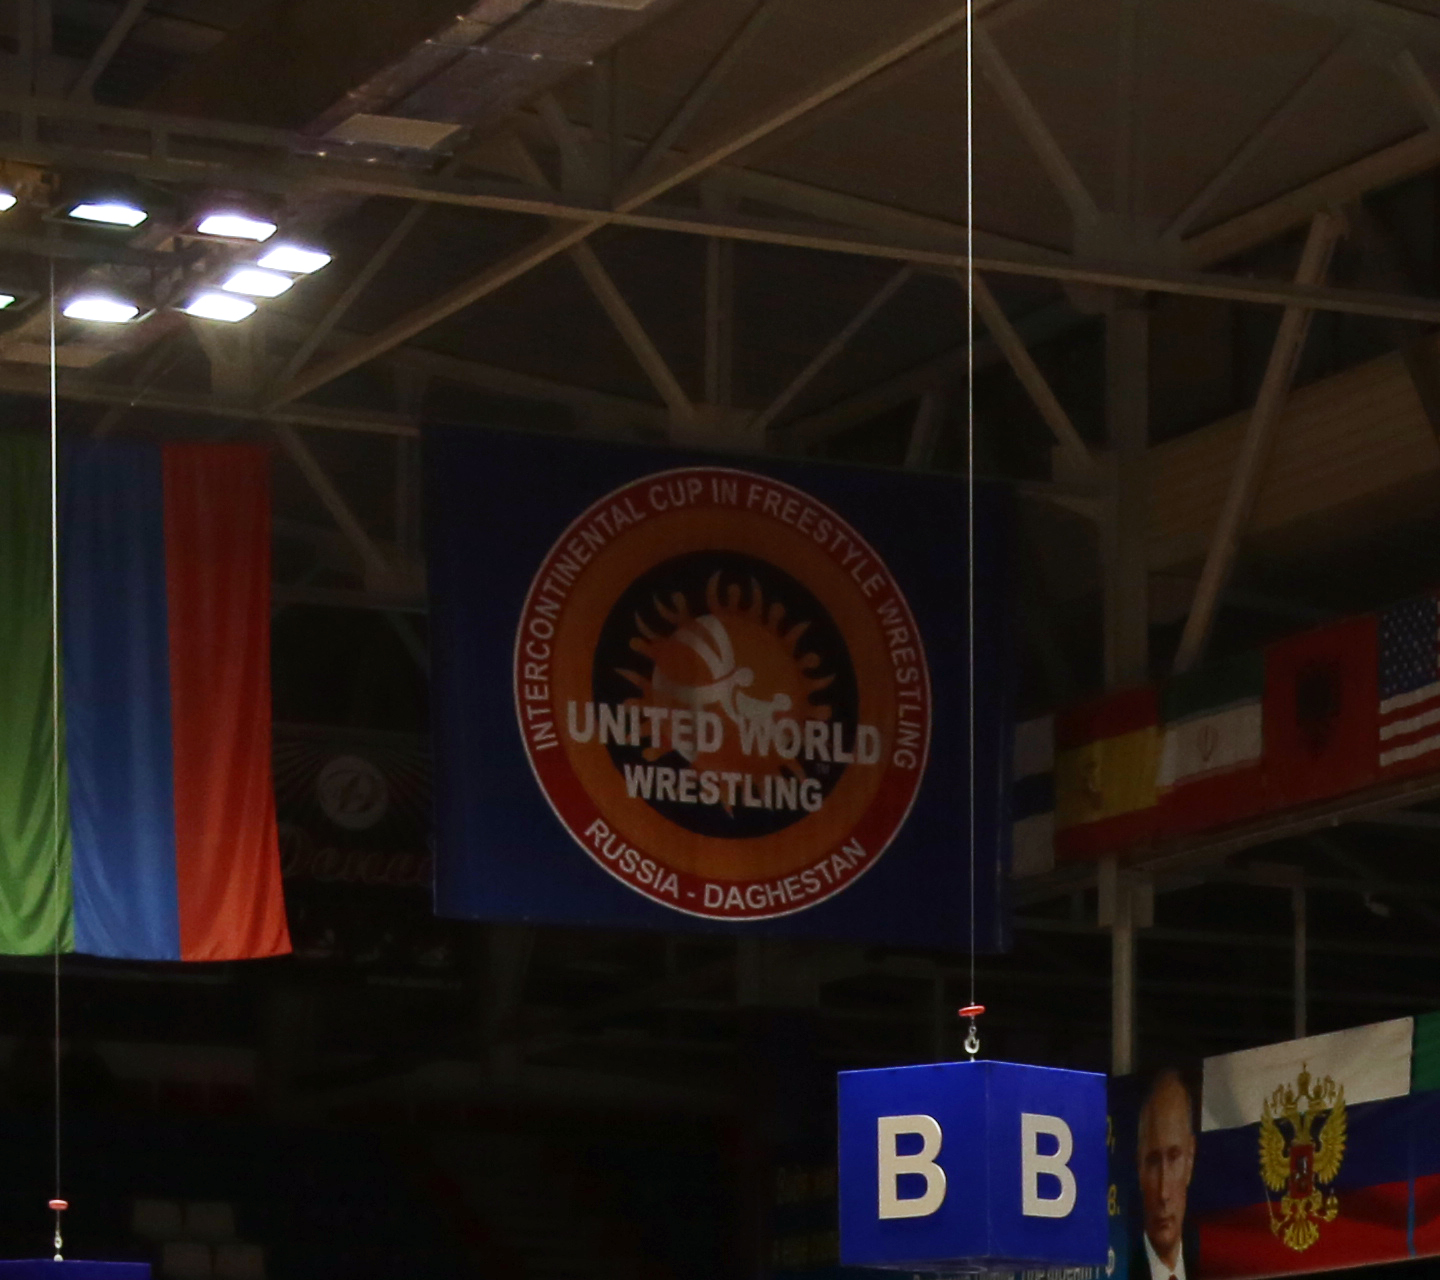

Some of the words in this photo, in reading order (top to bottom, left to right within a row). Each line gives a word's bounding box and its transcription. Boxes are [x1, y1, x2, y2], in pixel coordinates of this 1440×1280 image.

[522, 497, 646, 751] INTERCONTINENTAL
[649, 477, 703, 512] CUP
[711, 477, 738, 505] IN
[747, 485, 884, 598] FREESTYLE
[876, 598, 924, 772] WRESTLING
[567, 701, 724, 755] UNITED
[739, 719, 882, 766] WORLD
[624, 763, 824, 813] WRESTLING
[584, 818, 680, 899] RUSSIA
[703, 838, 866, 911] DAGHESTAN
[878, 1113, 947, 1220] B
[1020, 1112, 1077, 1218] B
